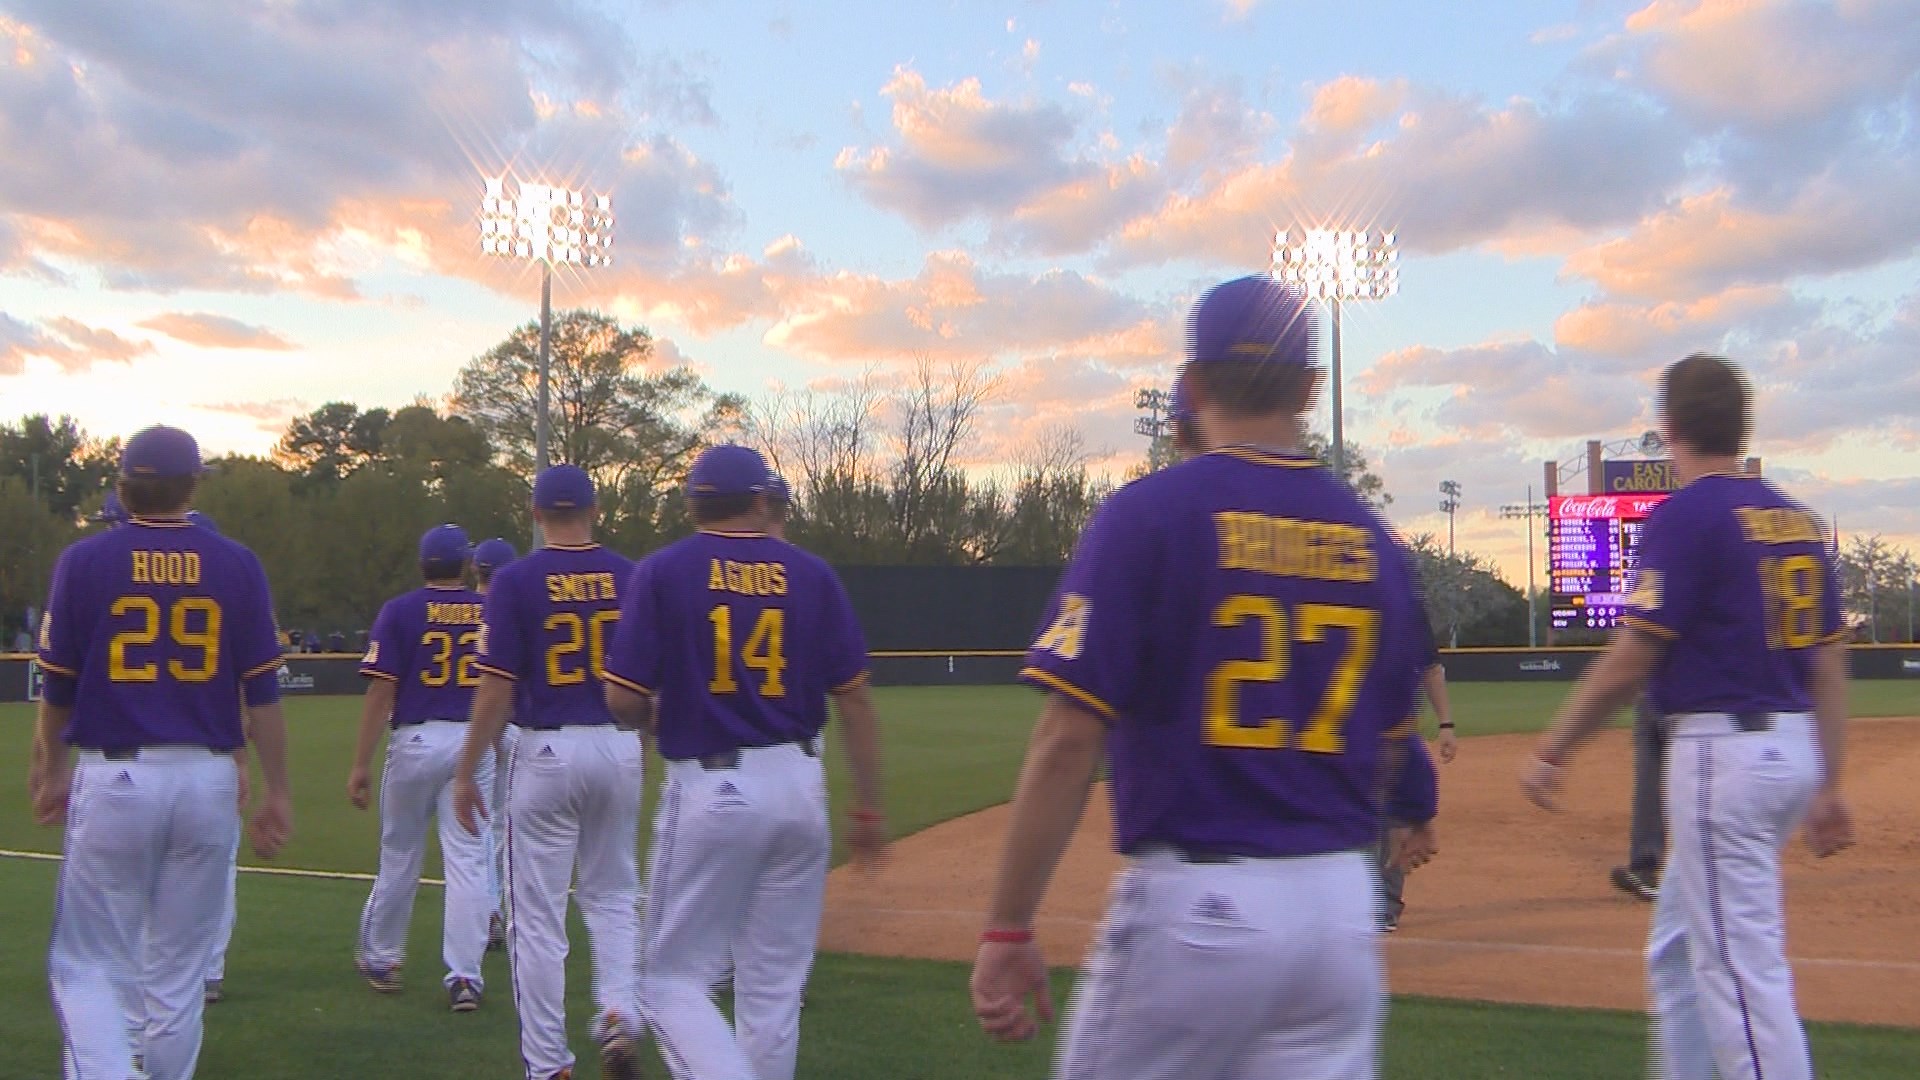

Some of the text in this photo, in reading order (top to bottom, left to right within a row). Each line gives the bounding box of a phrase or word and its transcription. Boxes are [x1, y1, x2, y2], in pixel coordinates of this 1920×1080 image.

[1634, 462, 1673, 477] EAST
[131, 550, 202, 584] HOOD
[545, 572, 617, 602] SMITH
[708, 558, 788, 596] AGNOS
[426, 601, 484, 625] MOORE
[1757, 555, 1825, 650] 18
[108, 596, 222, 683] 29
[419, 630, 484, 685] 32
[707, 604, 787, 697] 14
[1202, 594, 1382, 754] 27
